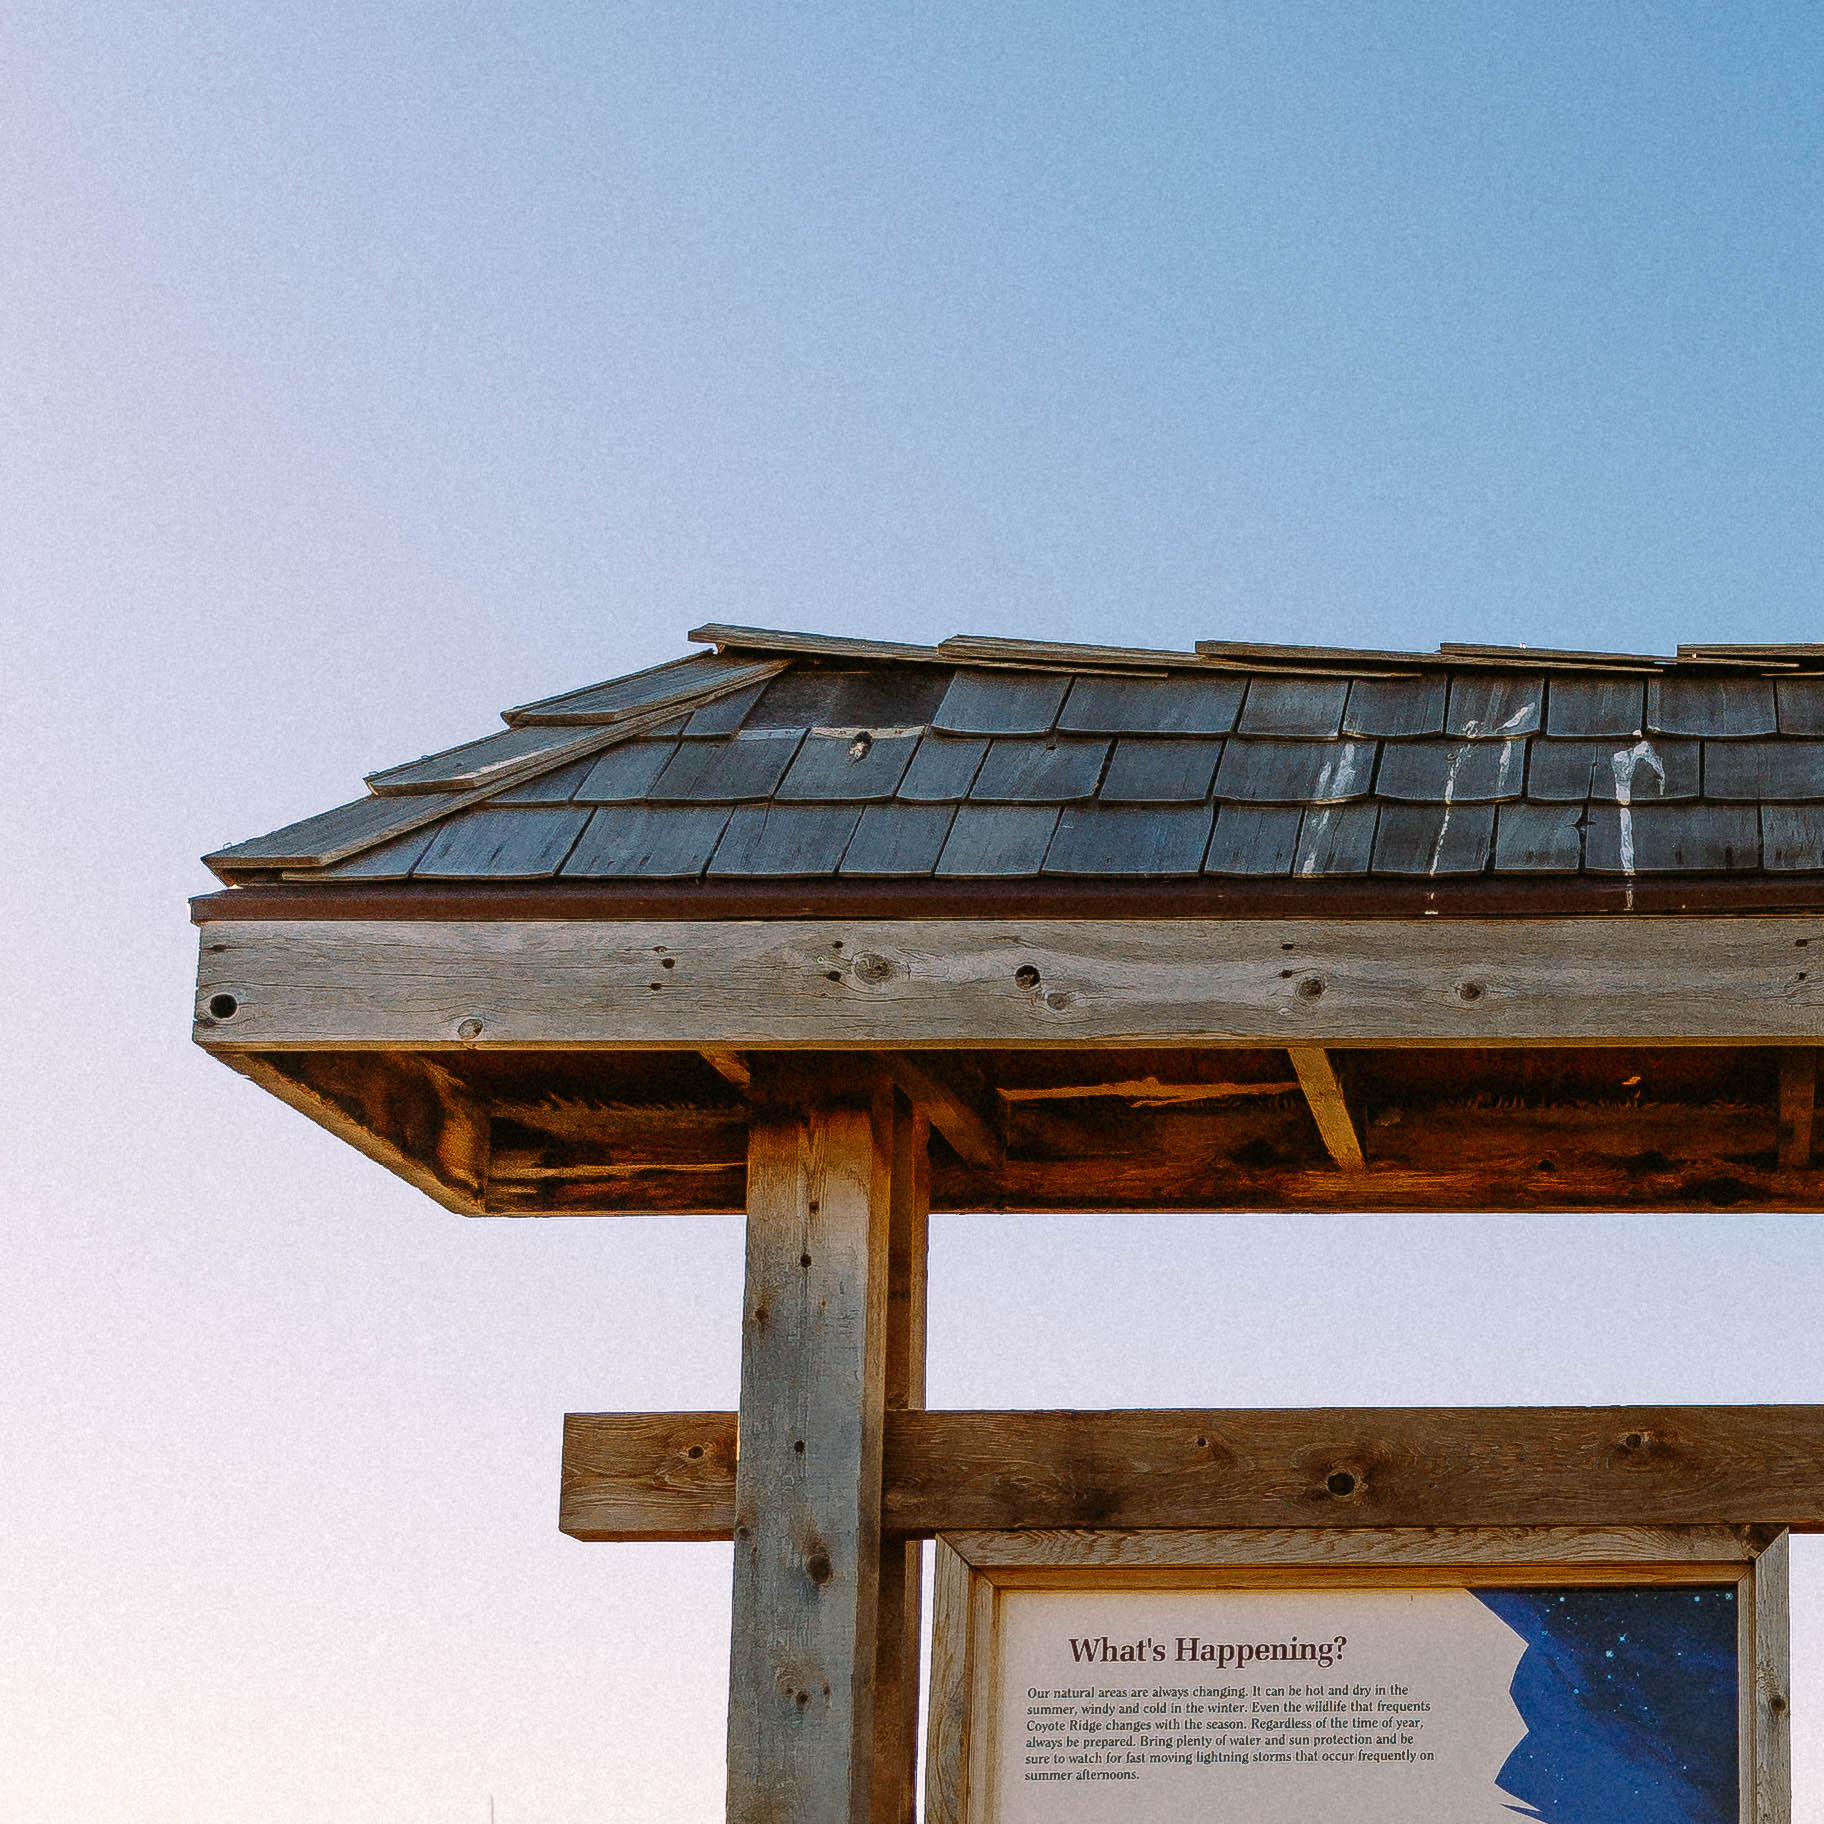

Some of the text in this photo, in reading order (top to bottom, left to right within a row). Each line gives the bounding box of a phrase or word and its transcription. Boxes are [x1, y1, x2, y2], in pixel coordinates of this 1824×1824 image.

[1068, 1636, 1347, 1669] What's Happening?
[1027, 1683, 1408, 1700] Our natural areas are always changing. It can be hot and dry in the
[1026, 1700, 1431, 1717] summer, windy and cold in the winter. Even the wildlife that frequents
[1024, 1768, 1139, 1781] summer afternoons.
